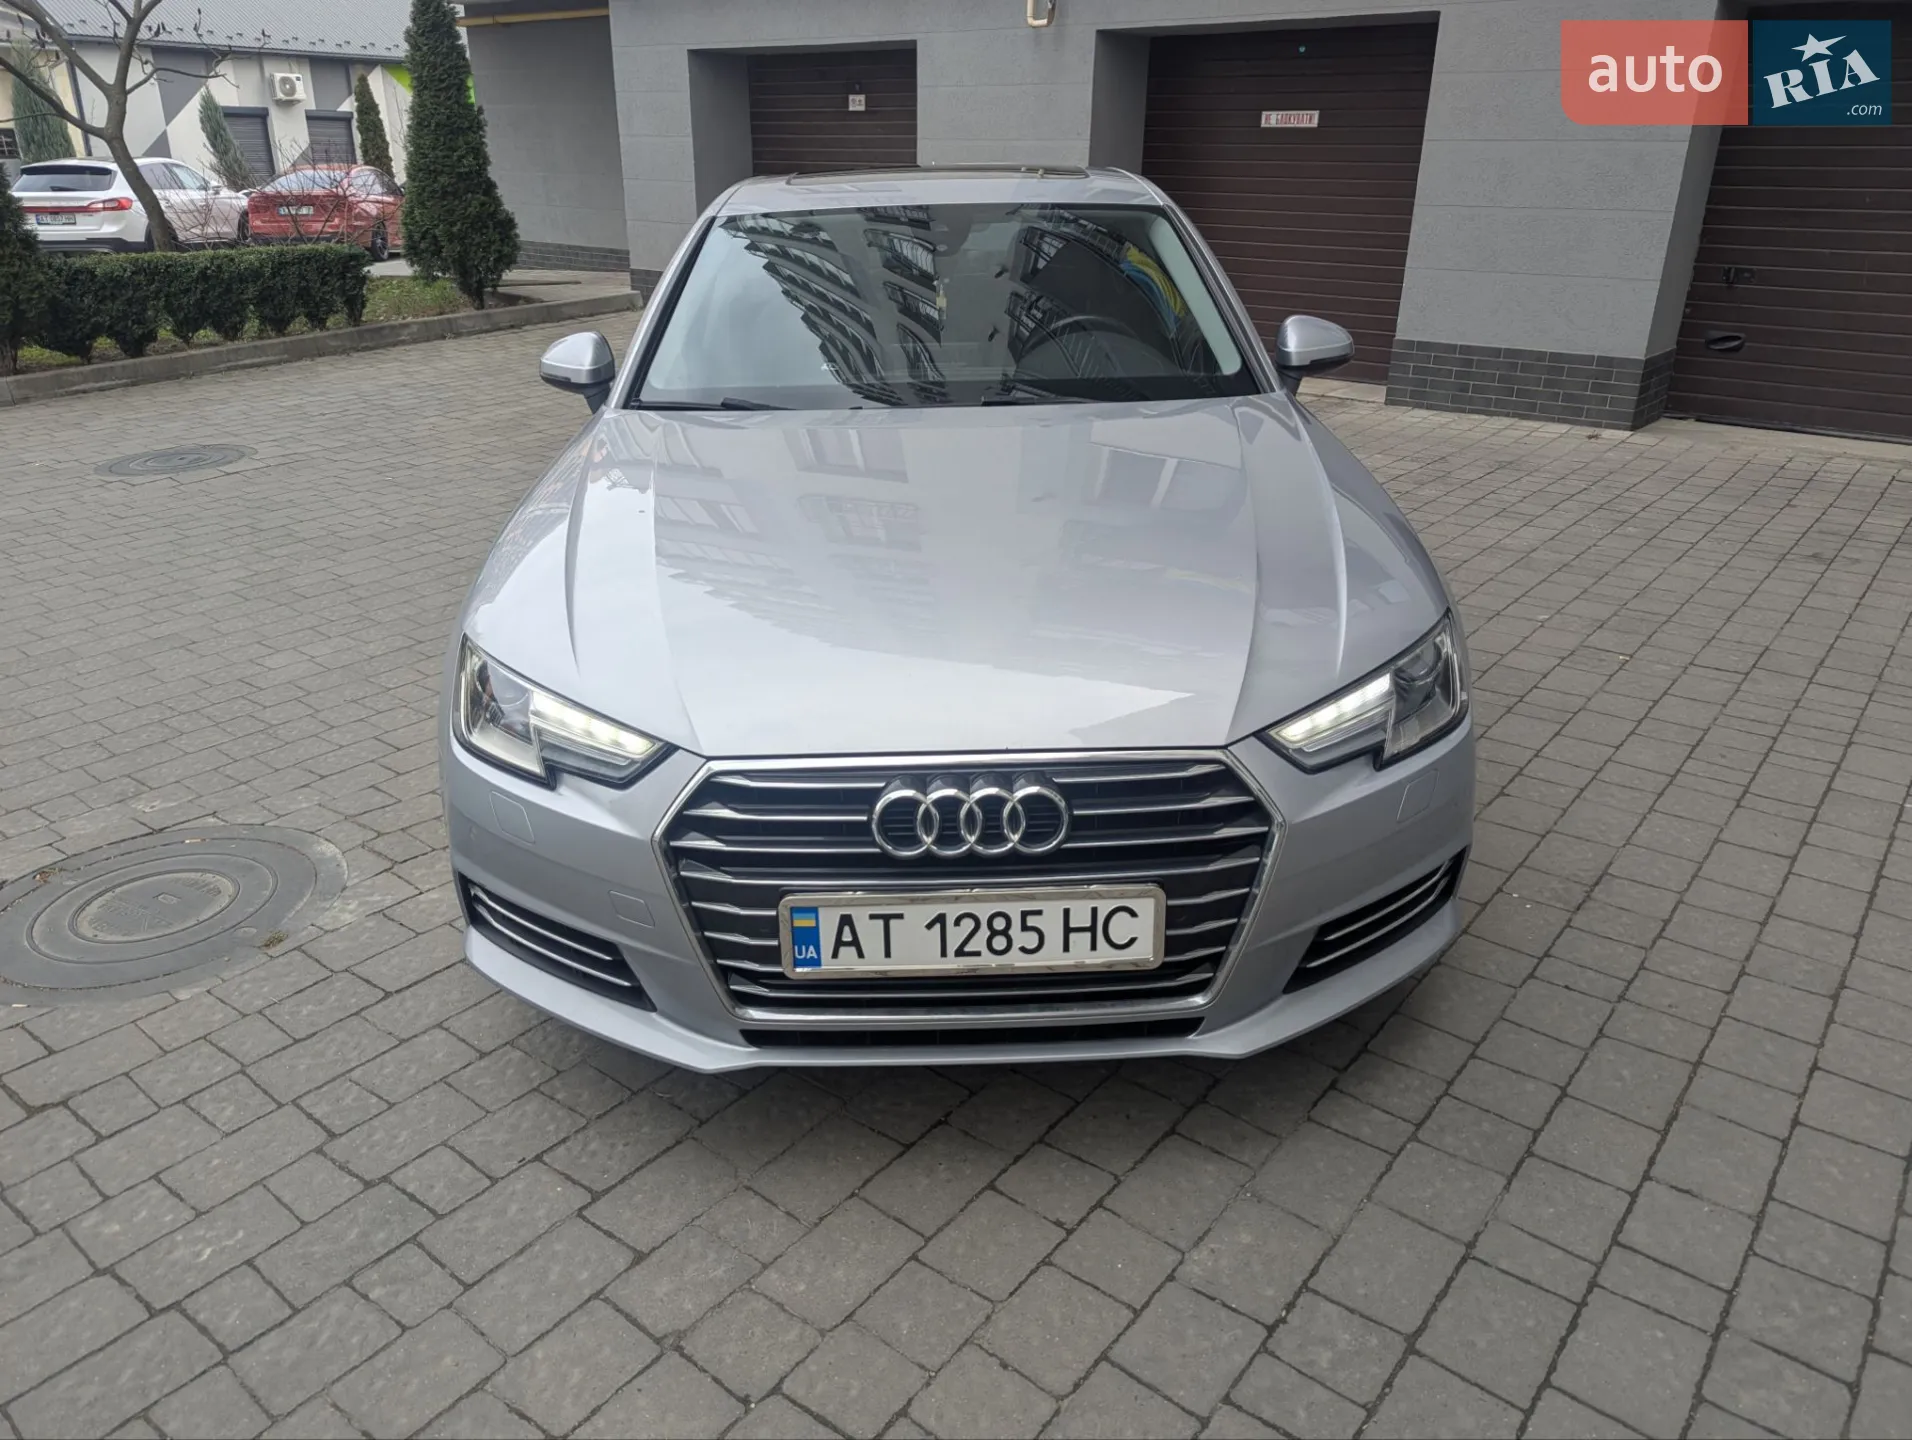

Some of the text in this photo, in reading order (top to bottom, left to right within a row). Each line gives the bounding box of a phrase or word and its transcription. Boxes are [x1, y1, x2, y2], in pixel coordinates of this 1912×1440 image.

[831, 904, 1139, 959] AT 1285 HC
[794, 945, 818, 959] UA
